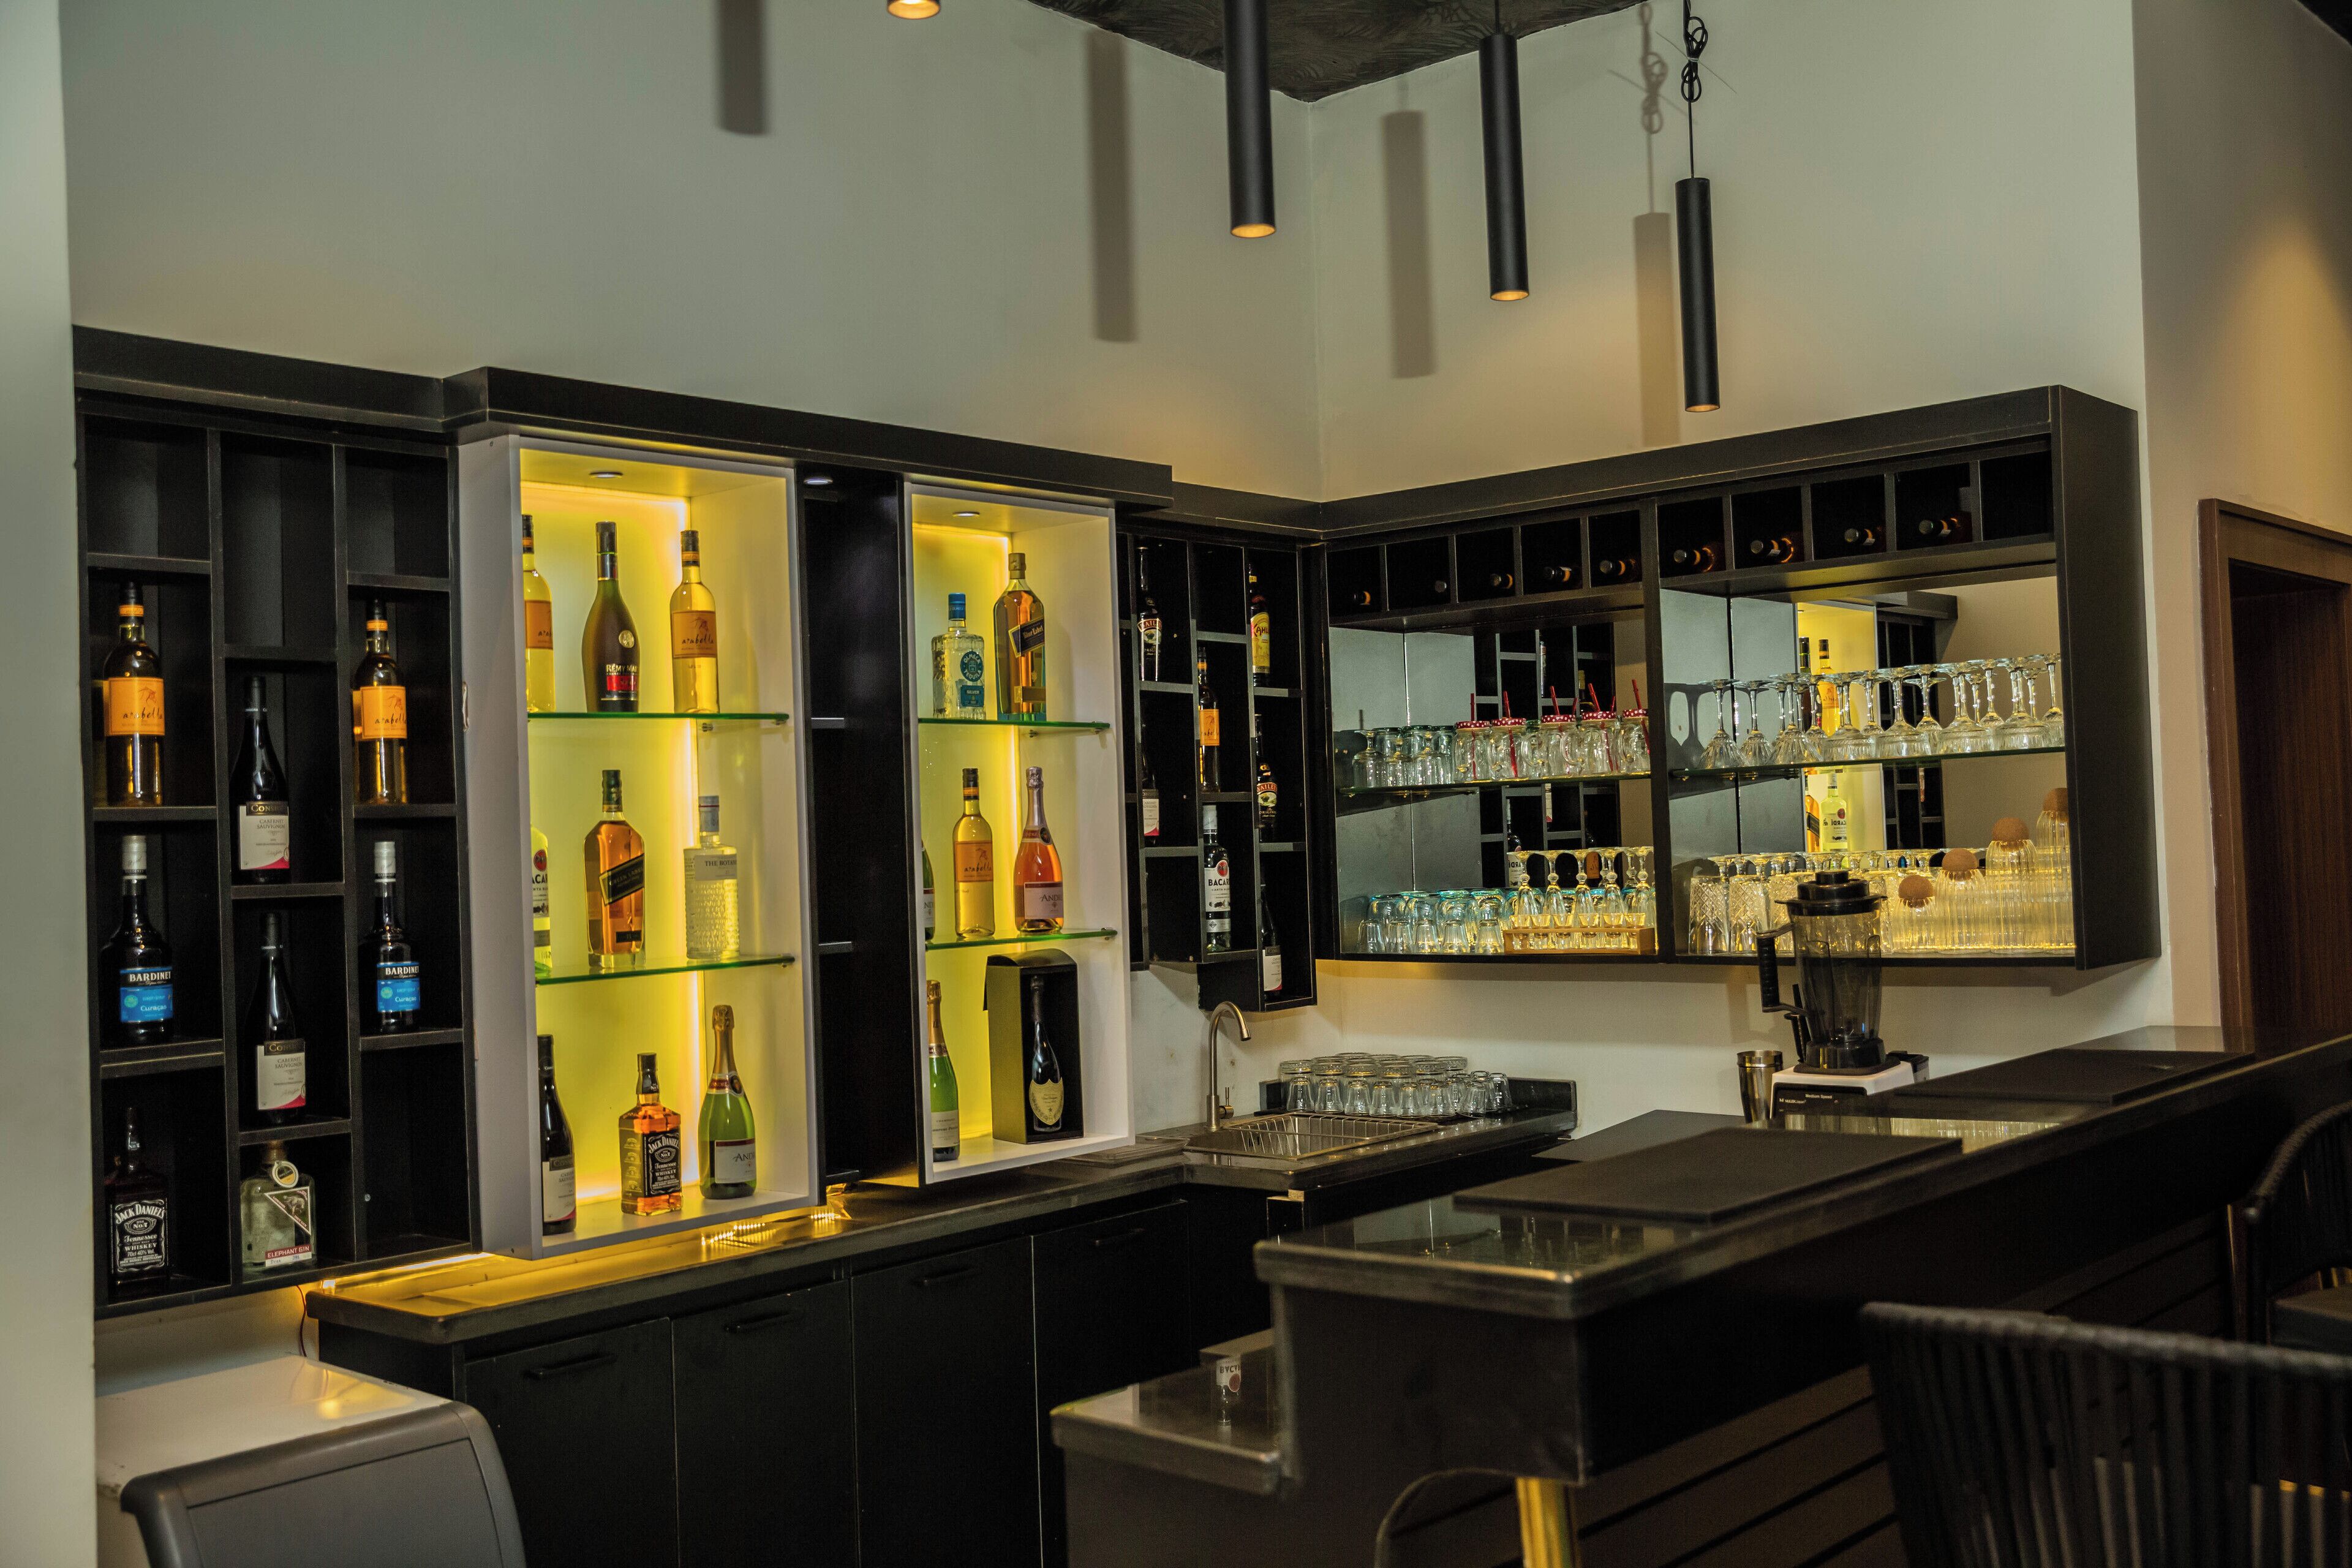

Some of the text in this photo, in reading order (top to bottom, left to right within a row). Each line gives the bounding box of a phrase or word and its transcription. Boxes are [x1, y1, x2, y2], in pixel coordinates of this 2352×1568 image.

[682, 633, 714, 644] arabella
[129, 971, 171, 982] BARDINET
[648, 1141, 662, 1153] JACK
[115, 1204, 165, 1224] JACK DANIEL'S
[124, 1234, 158, 1243] Tennessee
[268, 1248, 298, 1258] ELEPHANT
